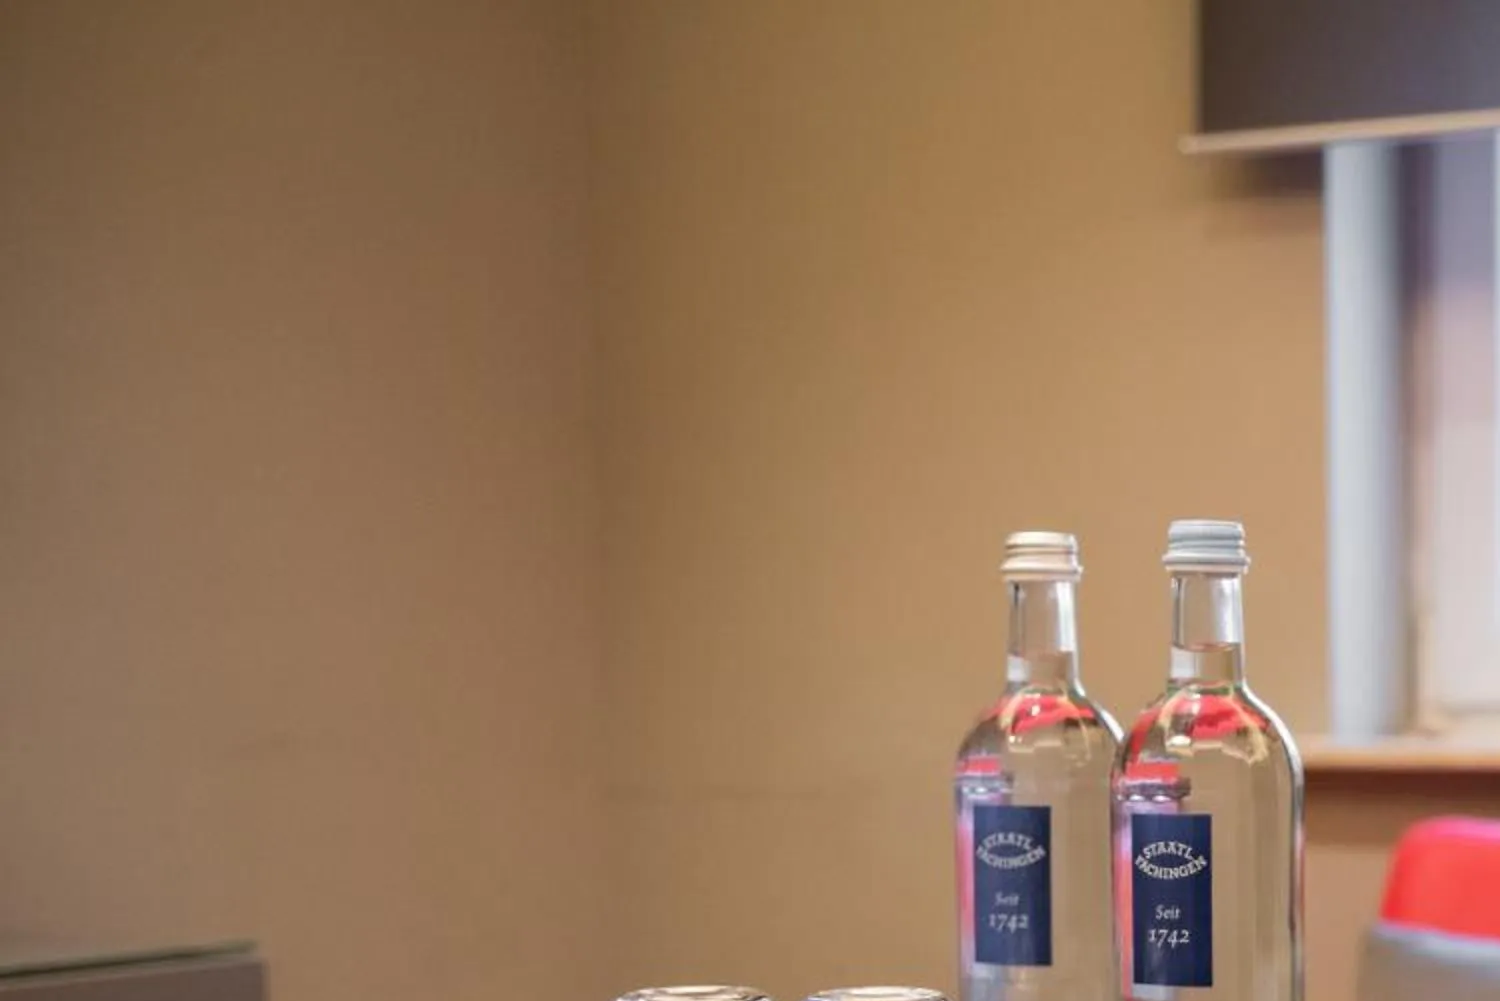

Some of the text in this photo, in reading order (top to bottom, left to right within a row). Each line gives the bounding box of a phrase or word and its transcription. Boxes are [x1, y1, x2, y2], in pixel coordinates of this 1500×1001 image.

[994, 891, 1020, 907] Seit
[1155, 904, 1181, 920] Seit
[989, 913, 1029, 934] 1742
[1148, 929, 1190, 949] 1742
